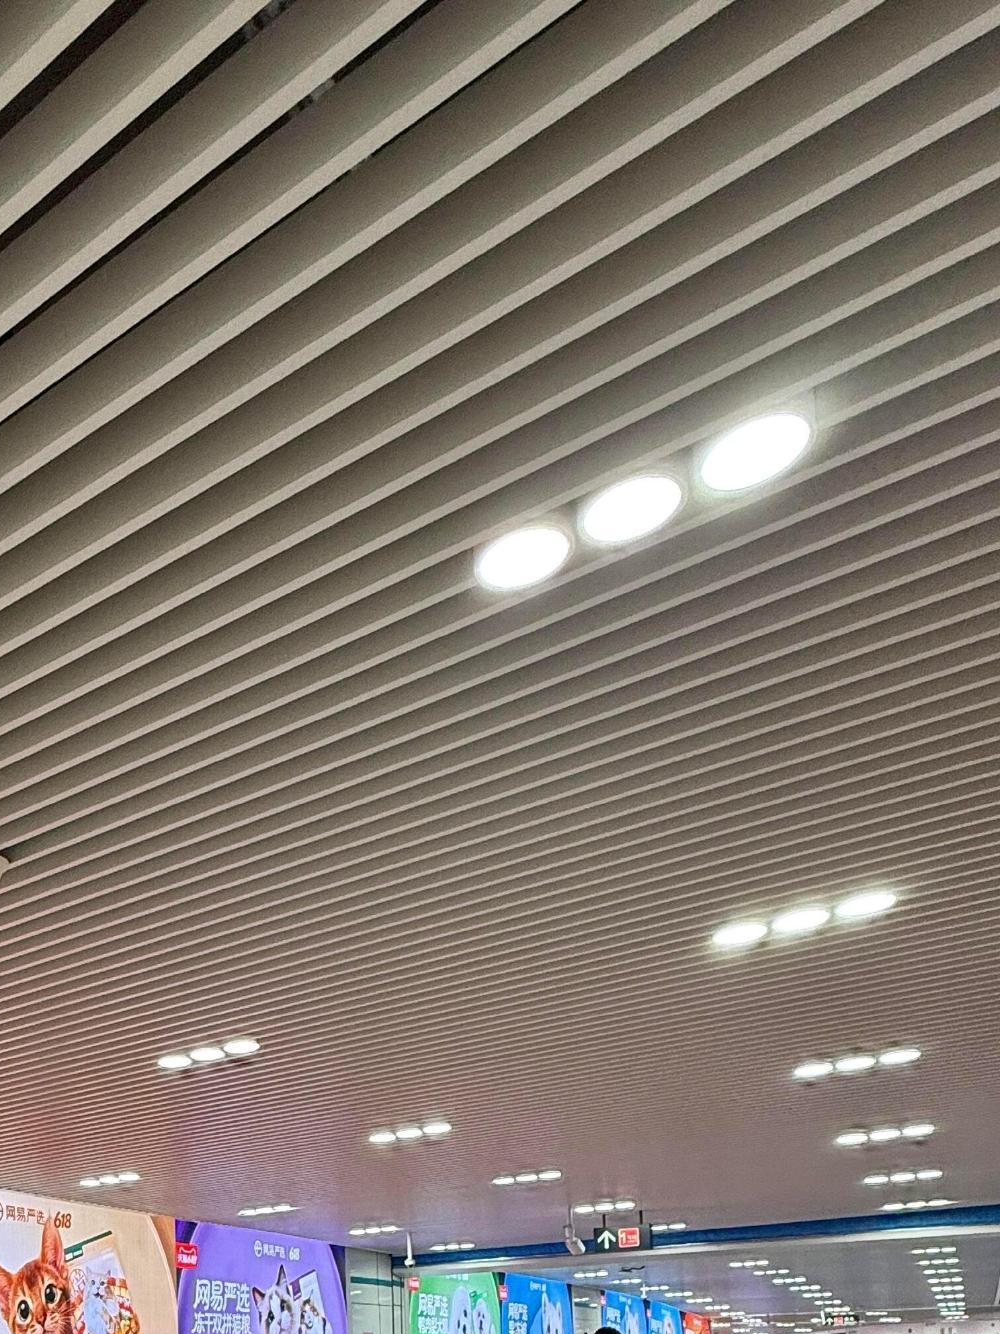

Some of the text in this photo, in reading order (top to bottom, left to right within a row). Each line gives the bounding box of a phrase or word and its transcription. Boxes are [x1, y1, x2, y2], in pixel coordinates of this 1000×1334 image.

[6, 1205, 72, 1228] 网易严选 618
[193, 1279, 250, 1313] 网易严选
